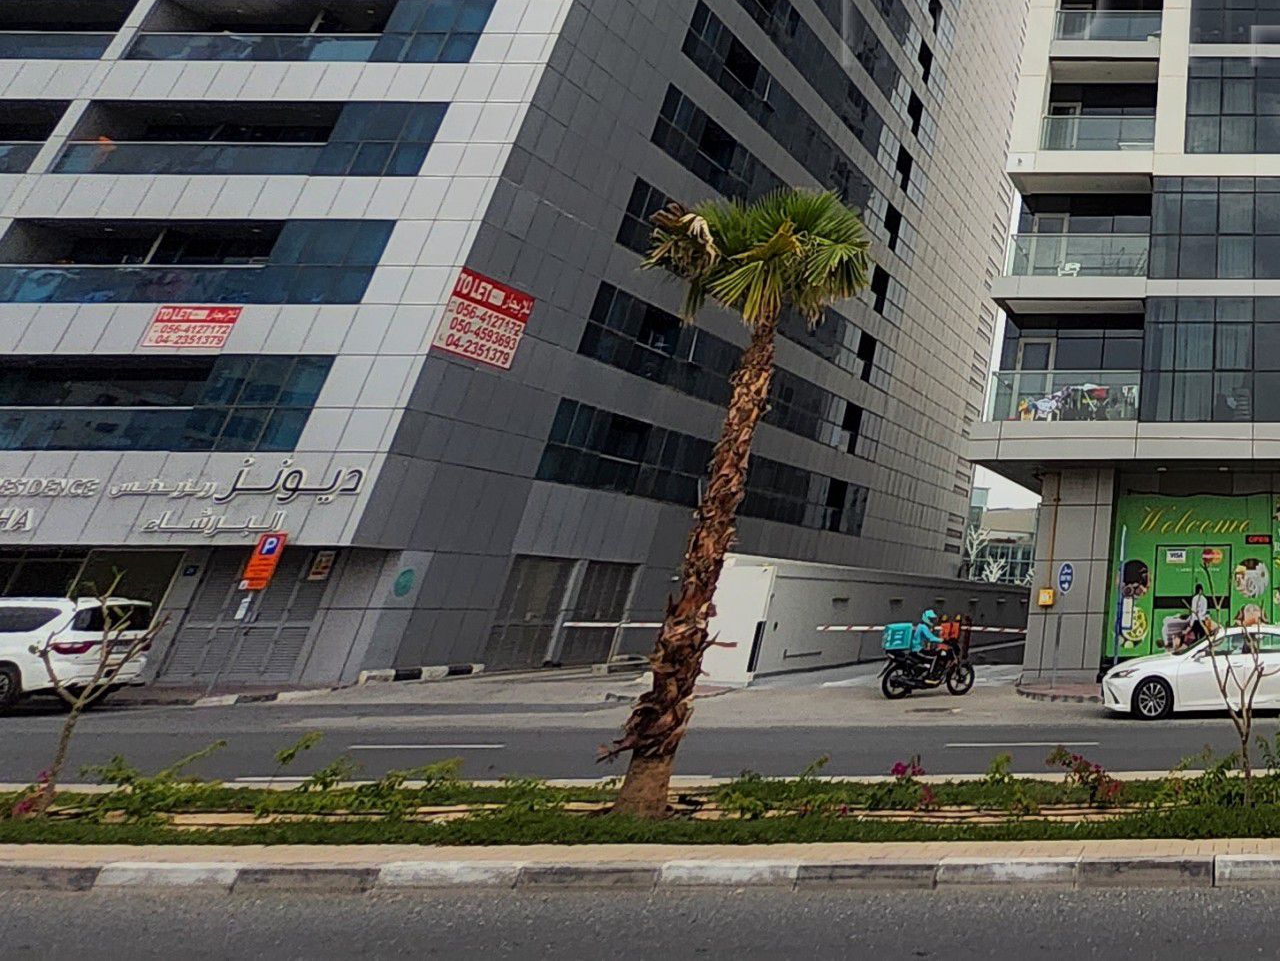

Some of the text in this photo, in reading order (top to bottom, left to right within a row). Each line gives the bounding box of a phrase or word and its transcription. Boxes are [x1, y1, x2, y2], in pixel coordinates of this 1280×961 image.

[456, 273, 493, 302] TO LET
[158, 308, 193, 320] TO LET
[456, 301, 522, 337] 056-4127172
[155, 334, 224, 345] 04-2351379
[160, 324, 231, 335] 056-4127172
[449, 317, 517, 351] 050-4593693
[445, 333, 510, 365] 04-2351379
[1137, 504, 1252, 535] Welcome
[261, 537, 278, 554] P
[1247, 535, 1270, 544] OPEN
